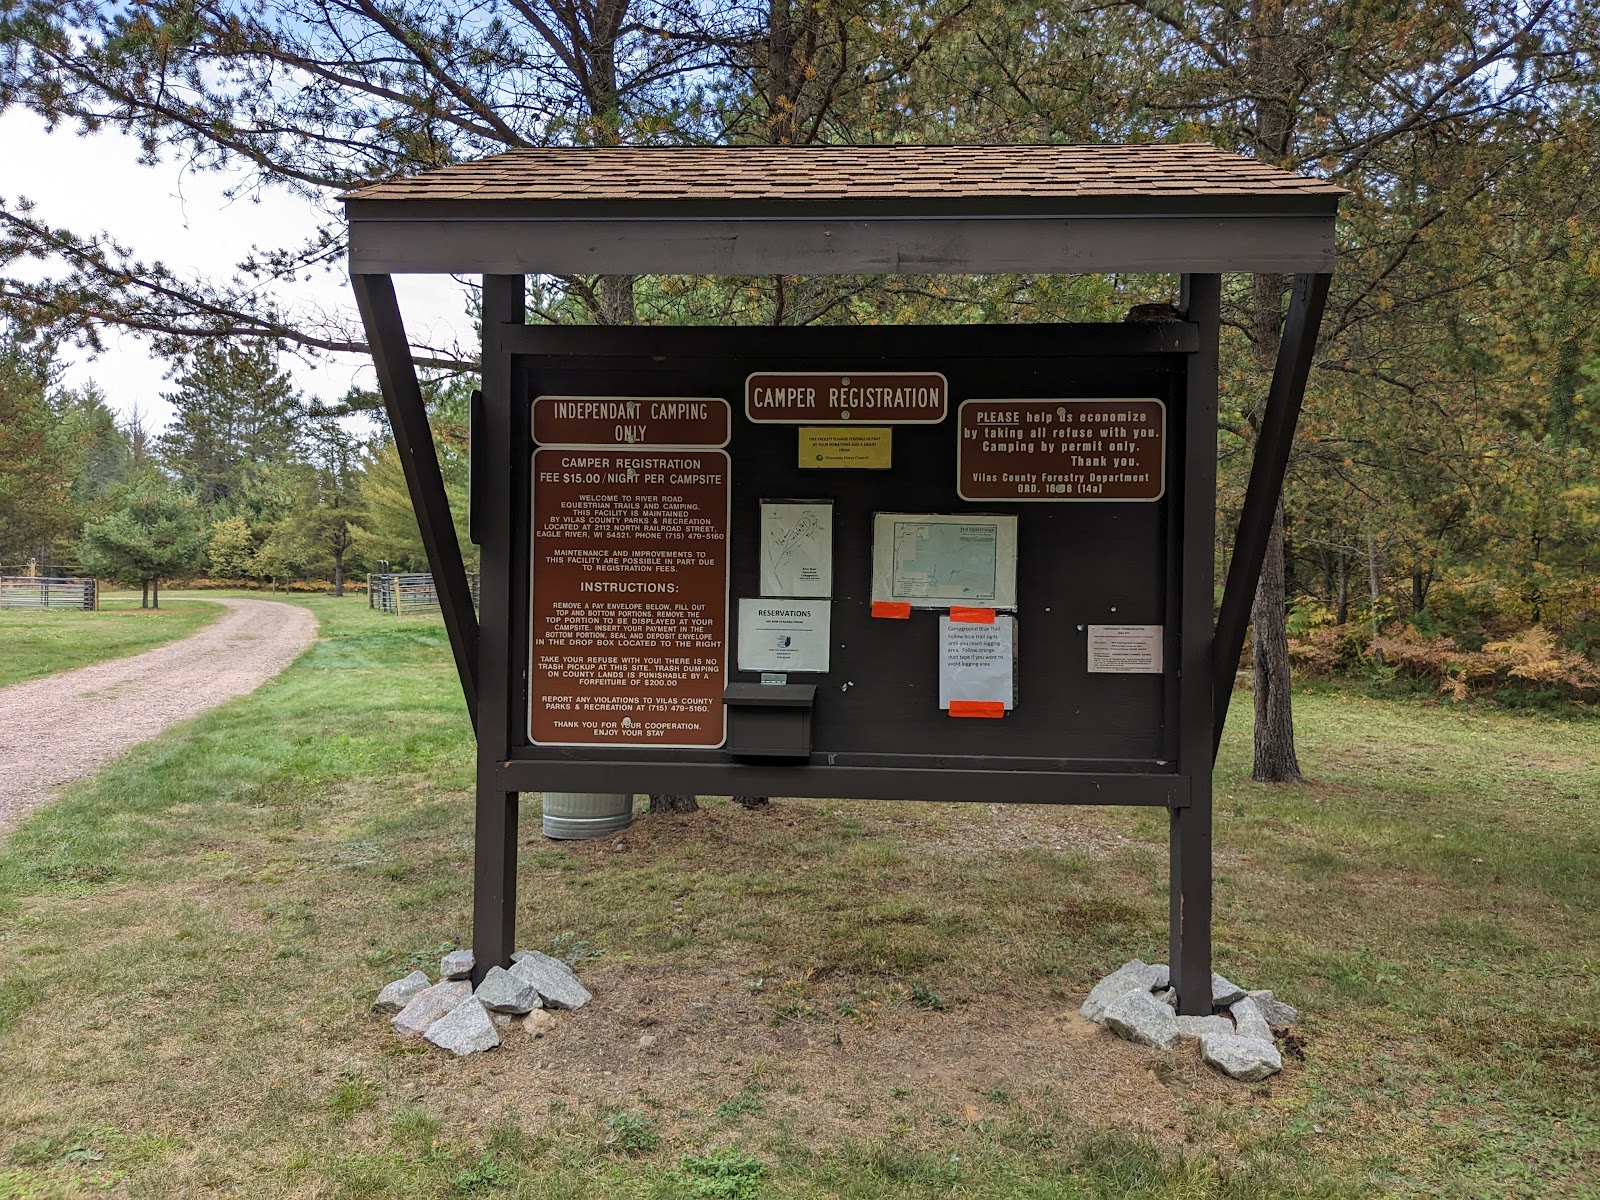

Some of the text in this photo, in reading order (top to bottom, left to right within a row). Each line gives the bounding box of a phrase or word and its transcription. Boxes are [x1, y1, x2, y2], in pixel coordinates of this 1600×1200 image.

[754, 388, 938, 408] CAMPER REGISTRATION
[554, 403, 707, 420] INDEPENDANT CAMPING
[977, 411, 1146, 423] PLEASE help us economize
[614, 425, 646, 442] ONLY
[964, 428, 1158, 439] by taking all refuse with you.
[982, 441, 1139, 453] Camping by permit only.
[561, 458, 700, 469] CAMPER REGISTRATION
[1070, 456, 1139, 468] Thank you.
[540, 473, 559, 483] FEE
[644, 474, 664, 484] PER
[669, 474, 721, 484] CAMPSITE
[972, 473, 1148, 483] Vilas County Forestry Department
[1018, 484, 1040, 493] ORD.
[1077, 484, 1102, 494] (14a)
[580, 582, 679, 593] INSTRUCTIONS:
